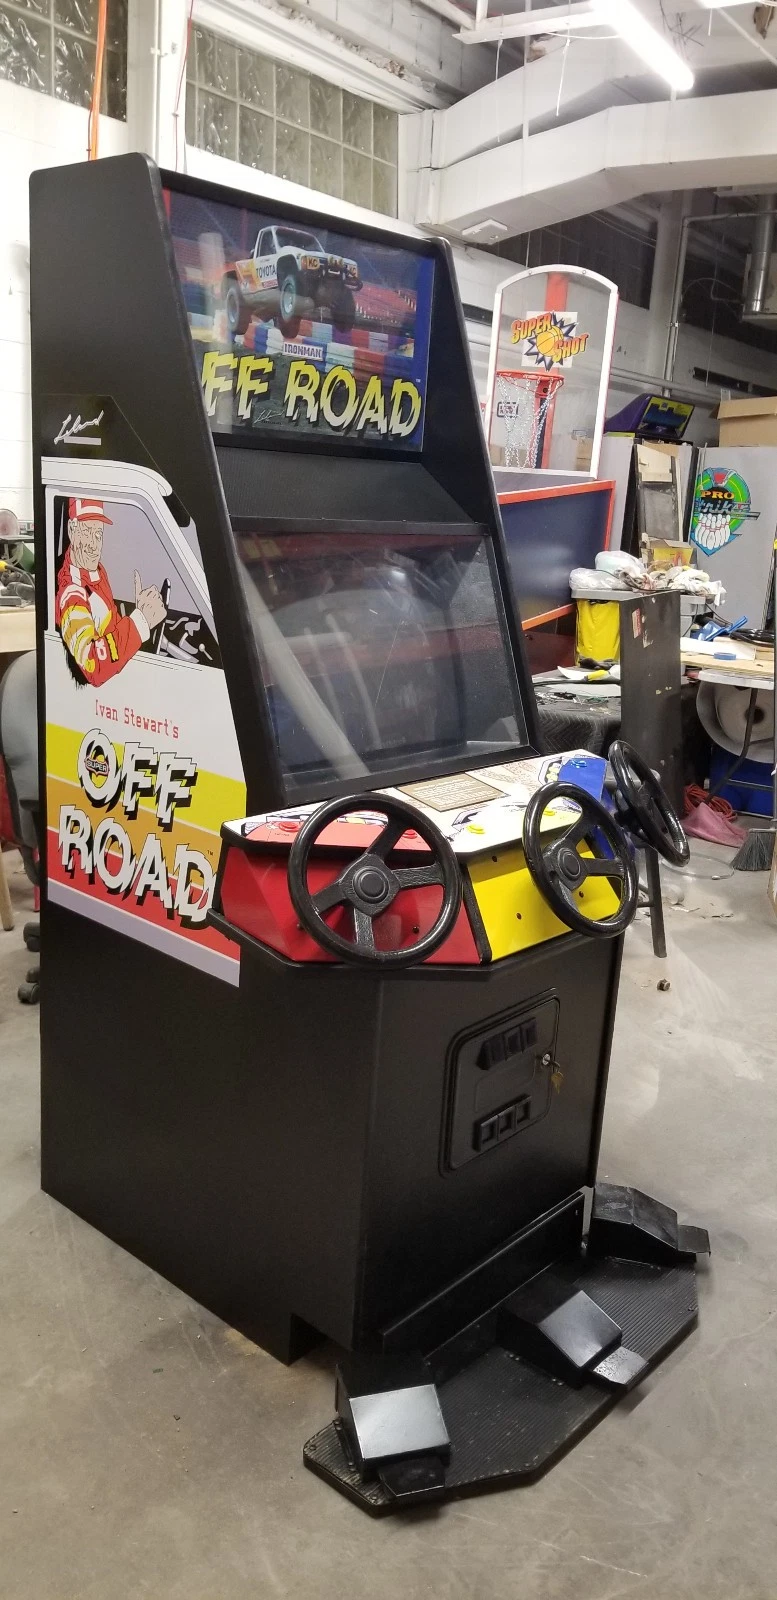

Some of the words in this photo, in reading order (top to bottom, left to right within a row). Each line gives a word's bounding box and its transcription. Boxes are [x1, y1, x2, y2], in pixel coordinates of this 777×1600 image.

[256, 264, 276, 278] TOYOTA
[510, 312, 552, 344] SUPER
[283, 343, 323, 358] IRONMAN
[551, 333, 589, 363] SHOT
[283, 360, 422, 437] ROAD
[701, 490, 735, 500] PRO
[95, 699, 119, 721] Ivan
[124, 707, 179, 739] Stewart's
[77, 728, 198, 826] OFF
[87, 761, 107, 773] SUPER
[58, 804, 217, 925] ROAD
